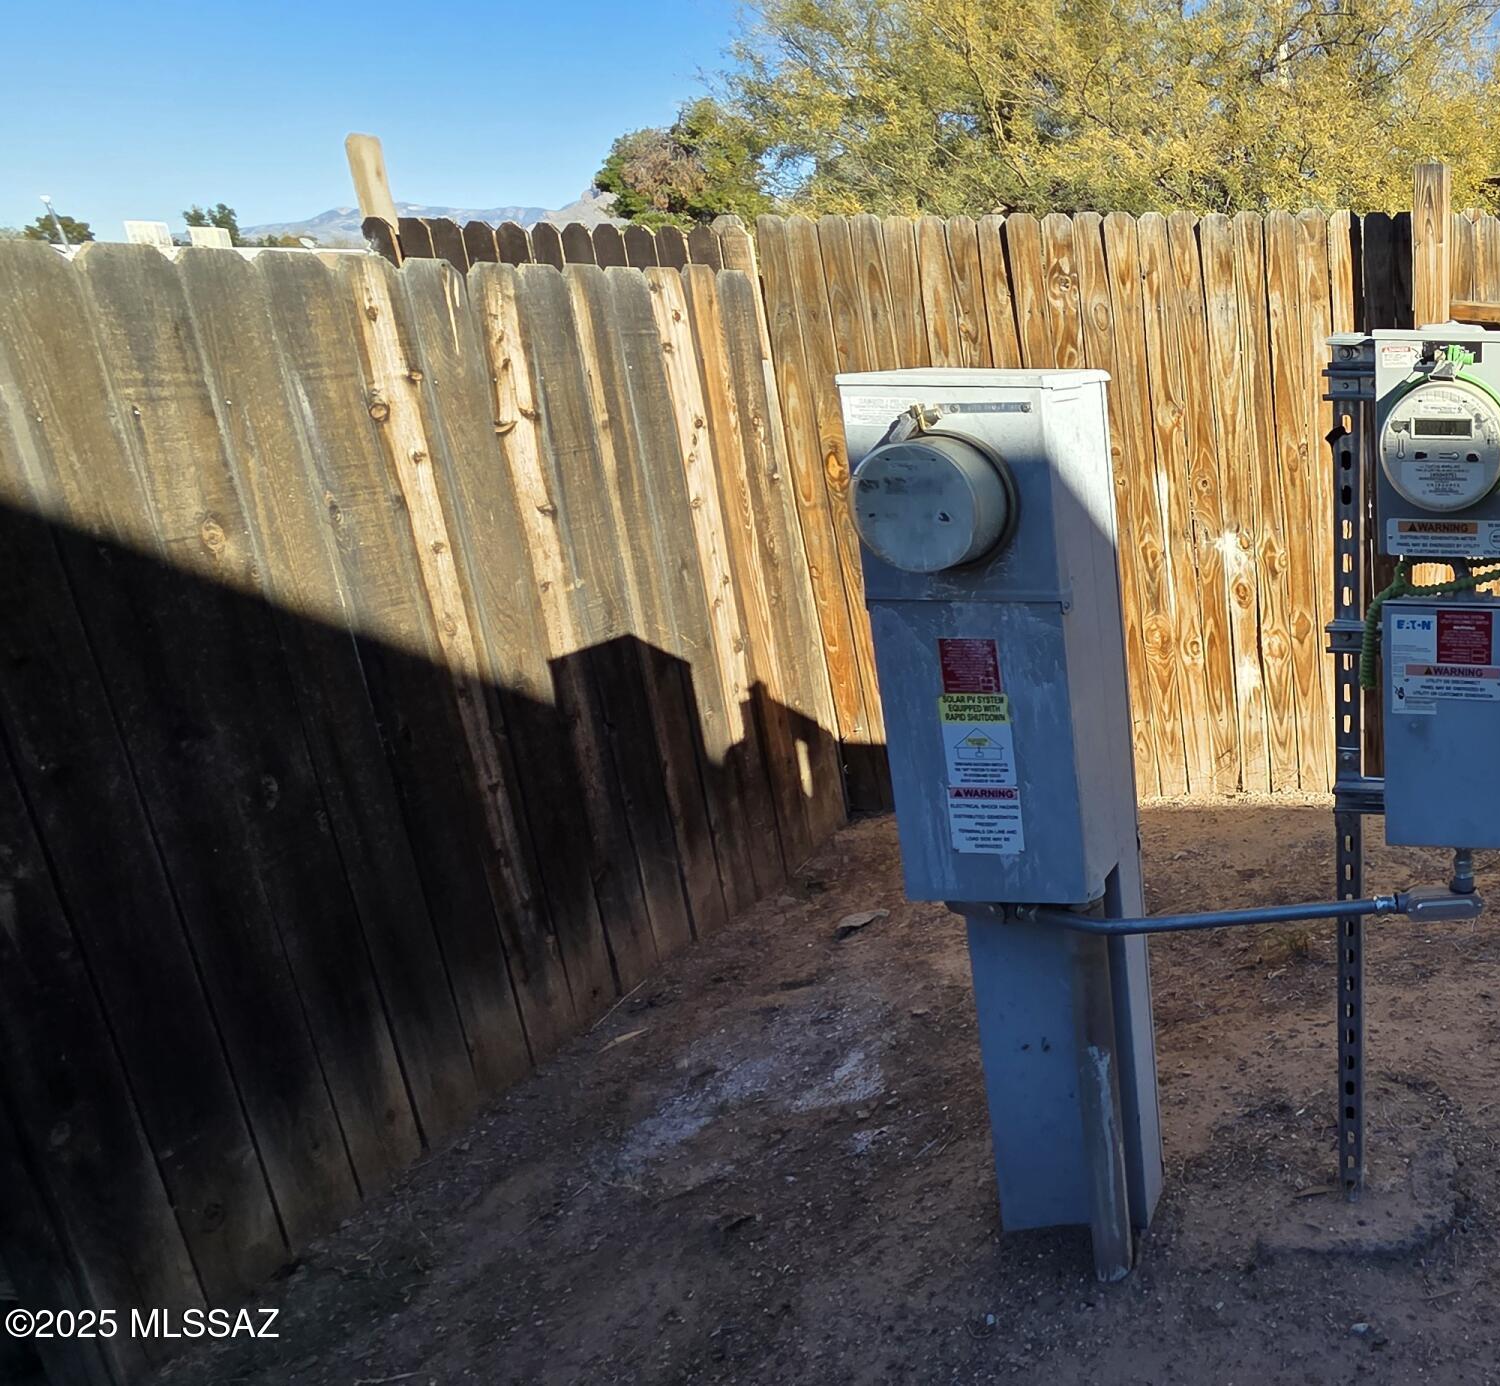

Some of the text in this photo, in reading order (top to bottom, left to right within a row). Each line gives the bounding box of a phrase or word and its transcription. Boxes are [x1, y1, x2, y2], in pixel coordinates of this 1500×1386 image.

[1418, 522, 1469, 532] WARNING
[1433, 667, 1484, 677] WARNING
[942, 695, 1004, 704] SOLAR PV SYSTEM
[947, 704, 1001, 713] EQUIPPED WITH
[944, 712, 1006, 722] RAPID SHUTDOWN
[961, 789, 1014, 799] WARNING
